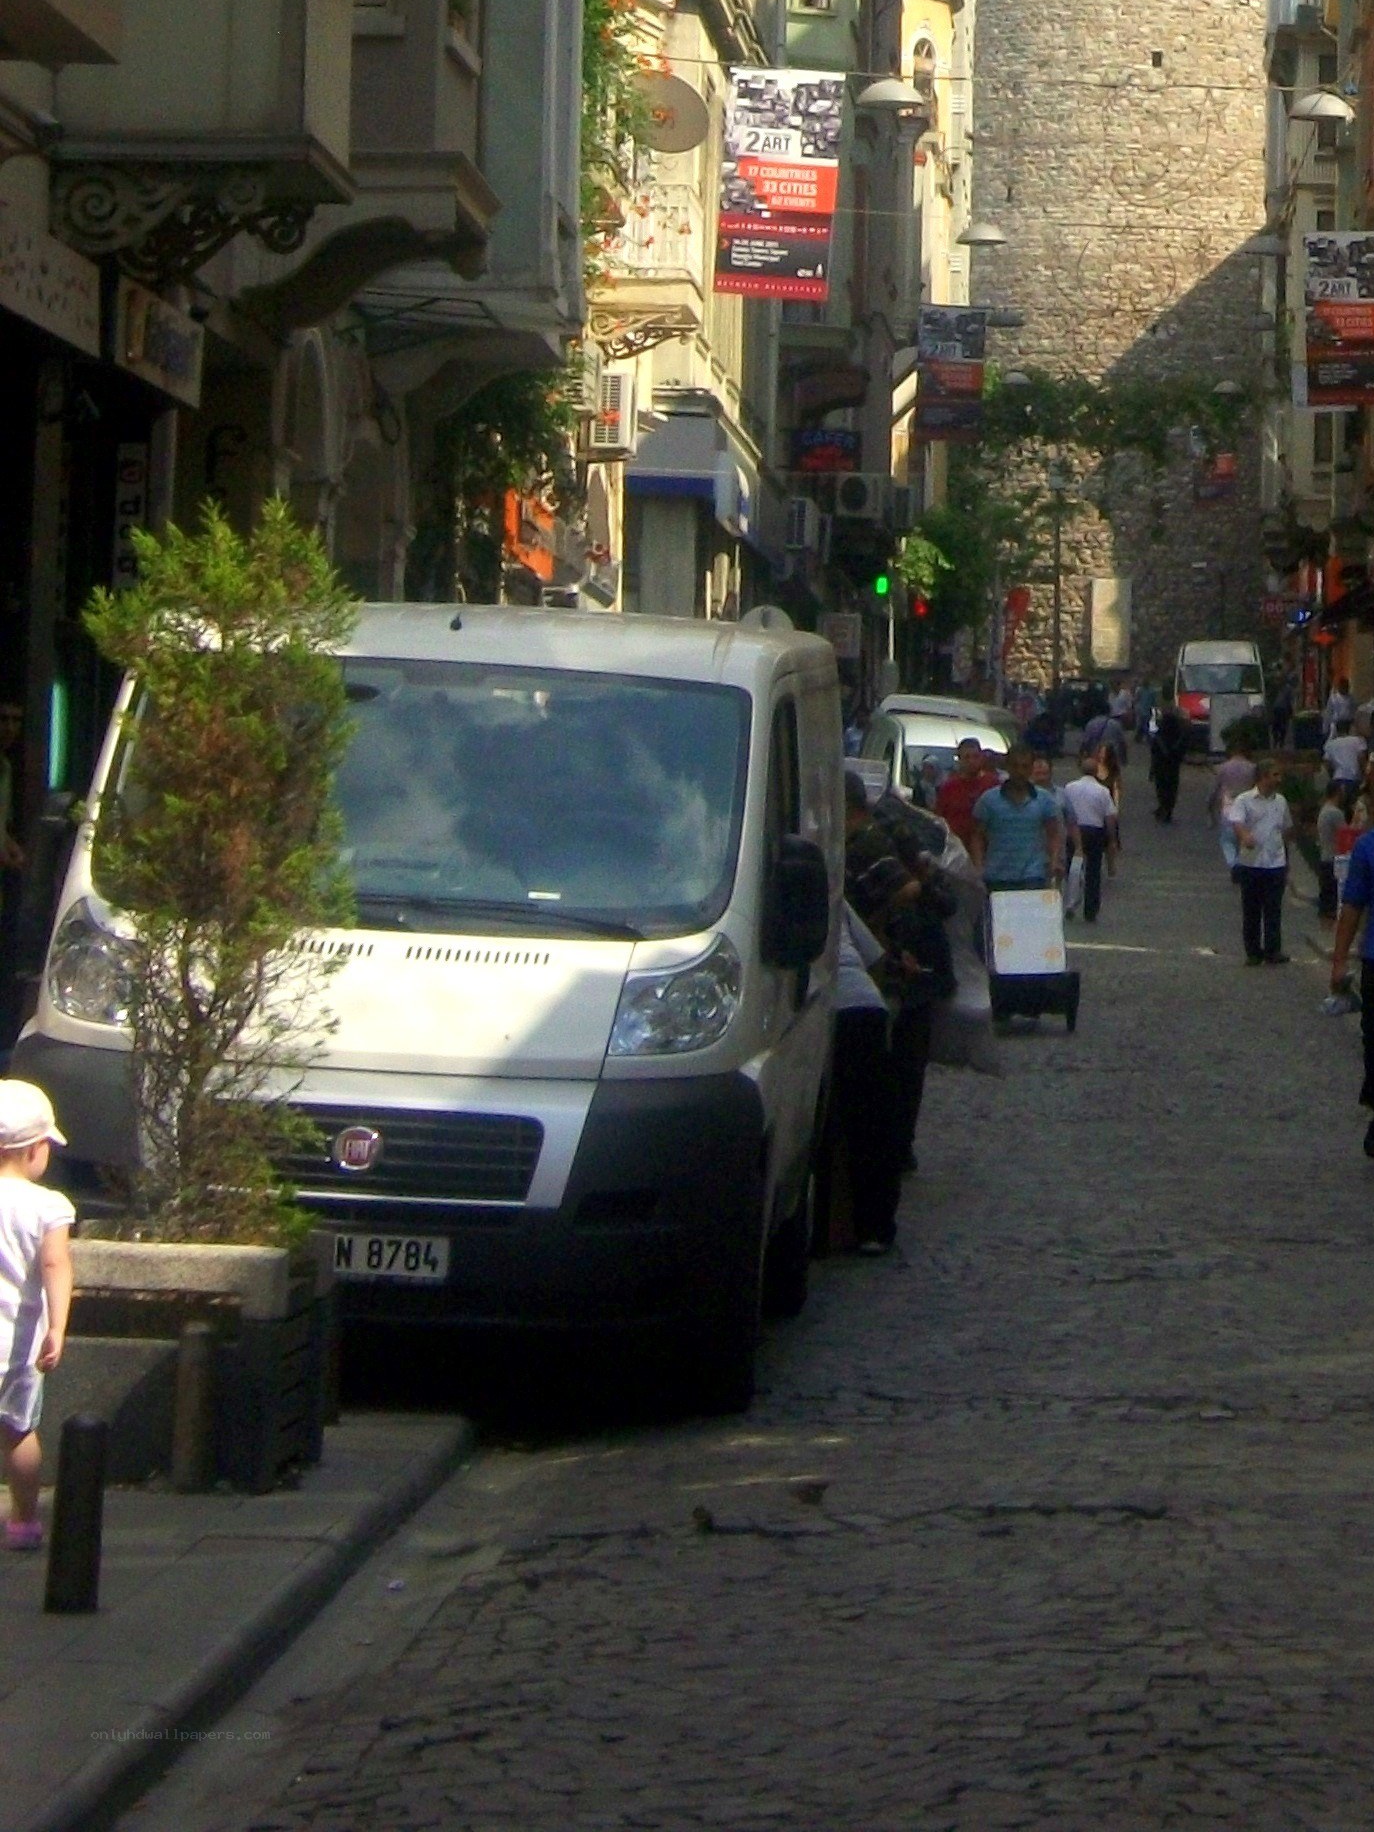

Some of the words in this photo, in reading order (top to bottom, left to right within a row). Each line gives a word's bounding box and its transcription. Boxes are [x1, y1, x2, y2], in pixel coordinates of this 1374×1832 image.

[746, 131, 760, 152] 2
[761, 136, 791, 153] ART
[763, 180, 777, 193] 33
[779, 181, 817, 195] CITIES
[368, 1238, 439, 1272] 8784
